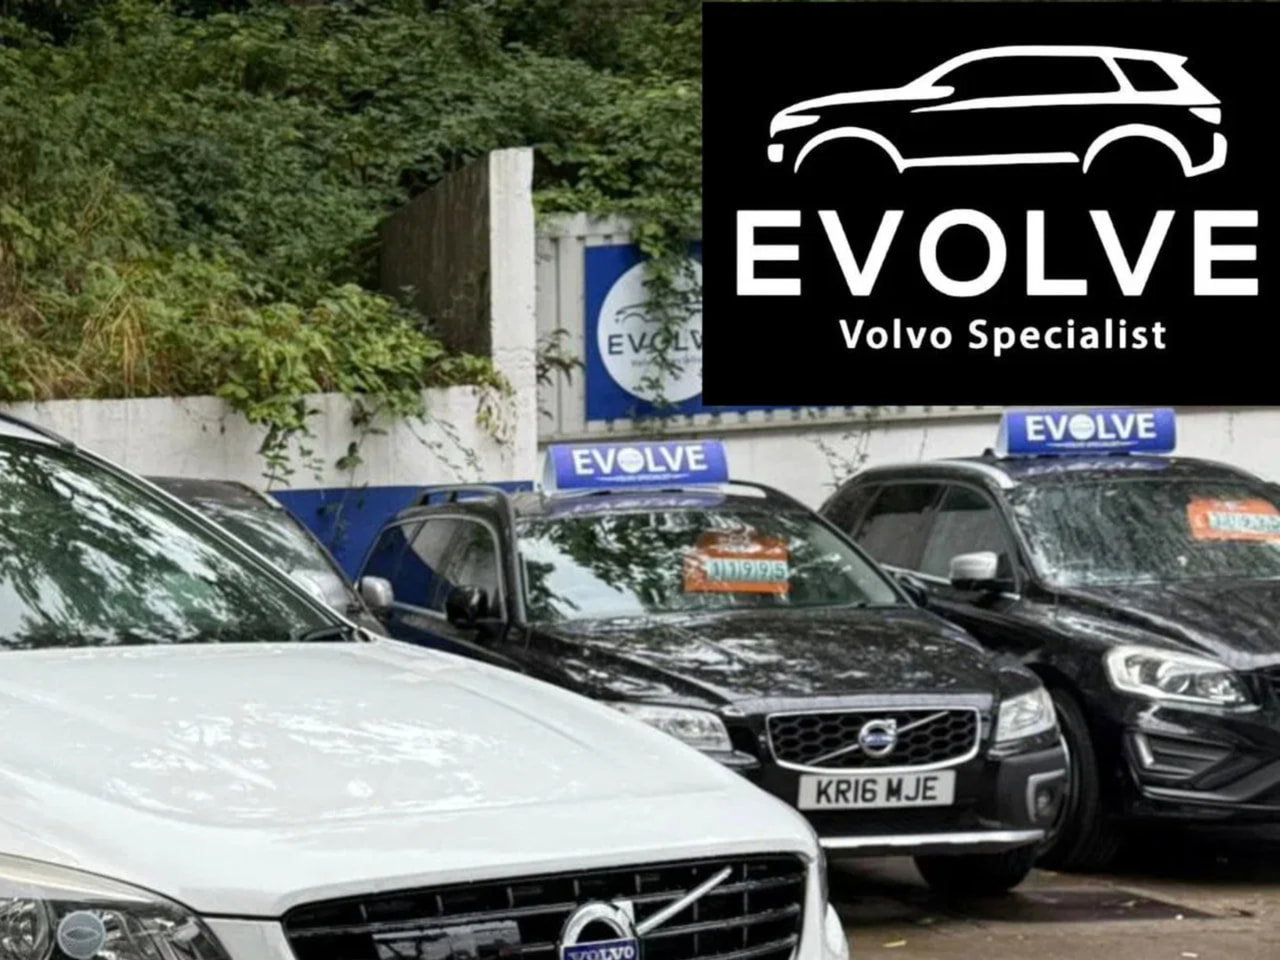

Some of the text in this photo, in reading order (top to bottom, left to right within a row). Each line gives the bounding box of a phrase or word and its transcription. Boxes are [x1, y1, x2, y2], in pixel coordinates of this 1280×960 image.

[607, 329, 703, 356] EVOLV
[1026, 414, 1157, 441] EVOLVE
[572, 445, 709, 475] EVOLVE
[816, 776, 938, 805] KR16 MJE
